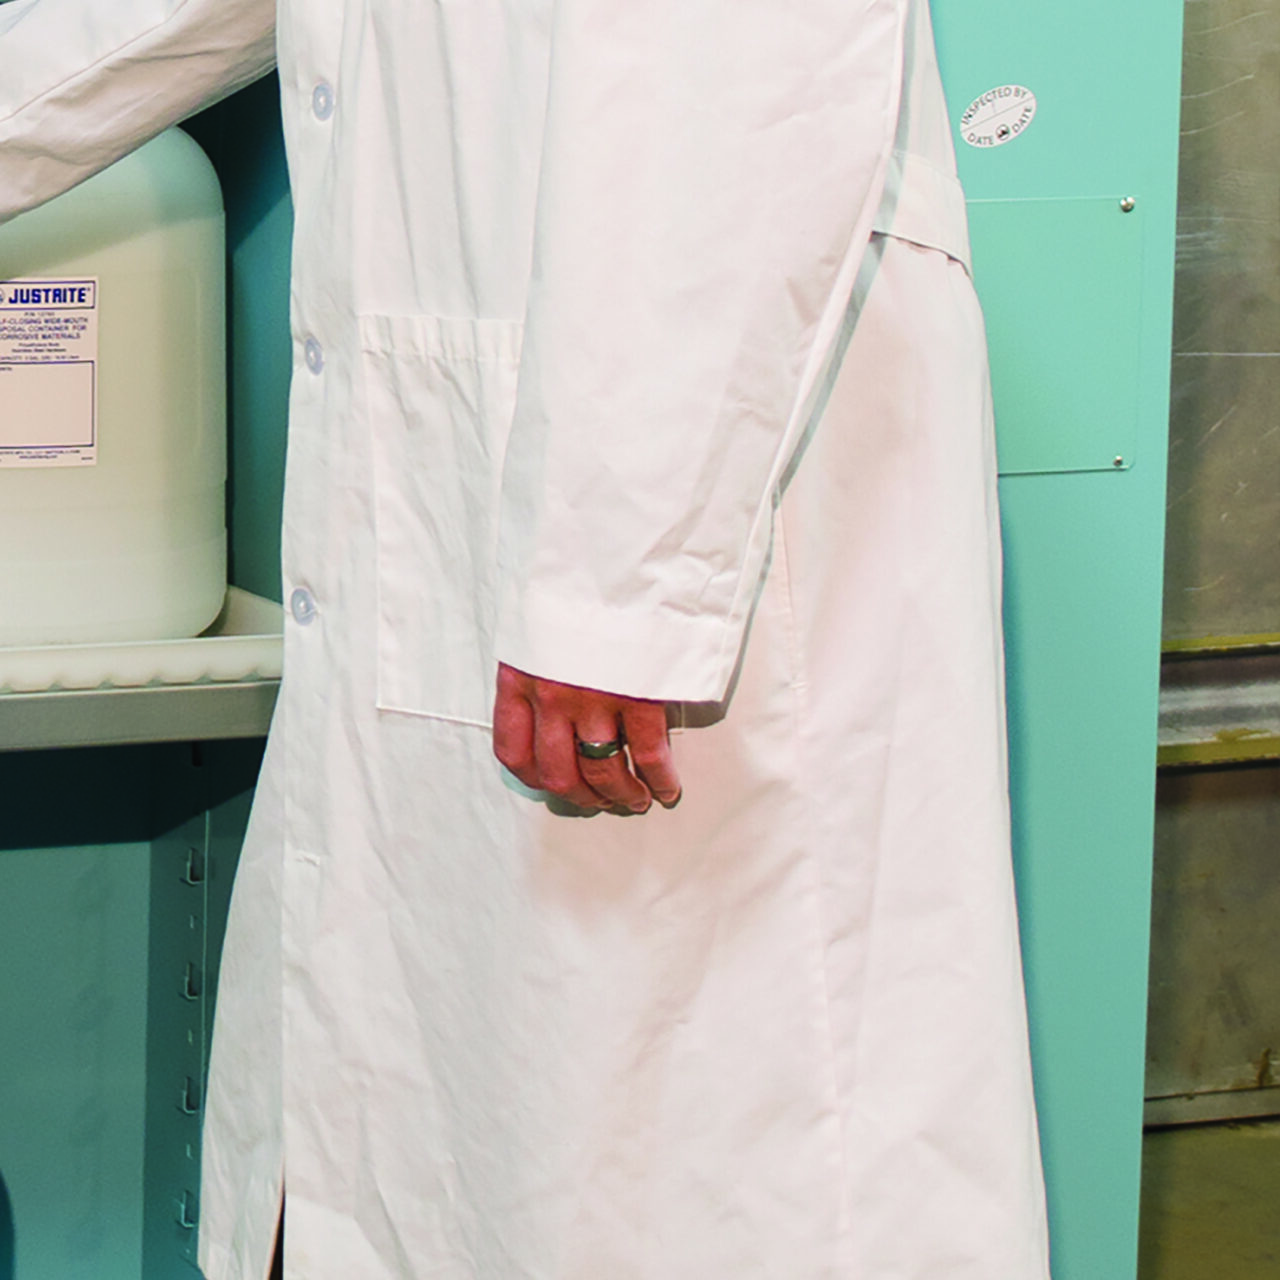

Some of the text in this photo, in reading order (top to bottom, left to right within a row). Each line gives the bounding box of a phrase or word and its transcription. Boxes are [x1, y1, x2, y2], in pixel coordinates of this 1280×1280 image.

[960, 86, 1028, 126] INSPECTED BY
[1011, 106, 1032, 134] DATE
[967, 132, 994, 145] DATE
[41, 332, 80, 340] MATERIALS
